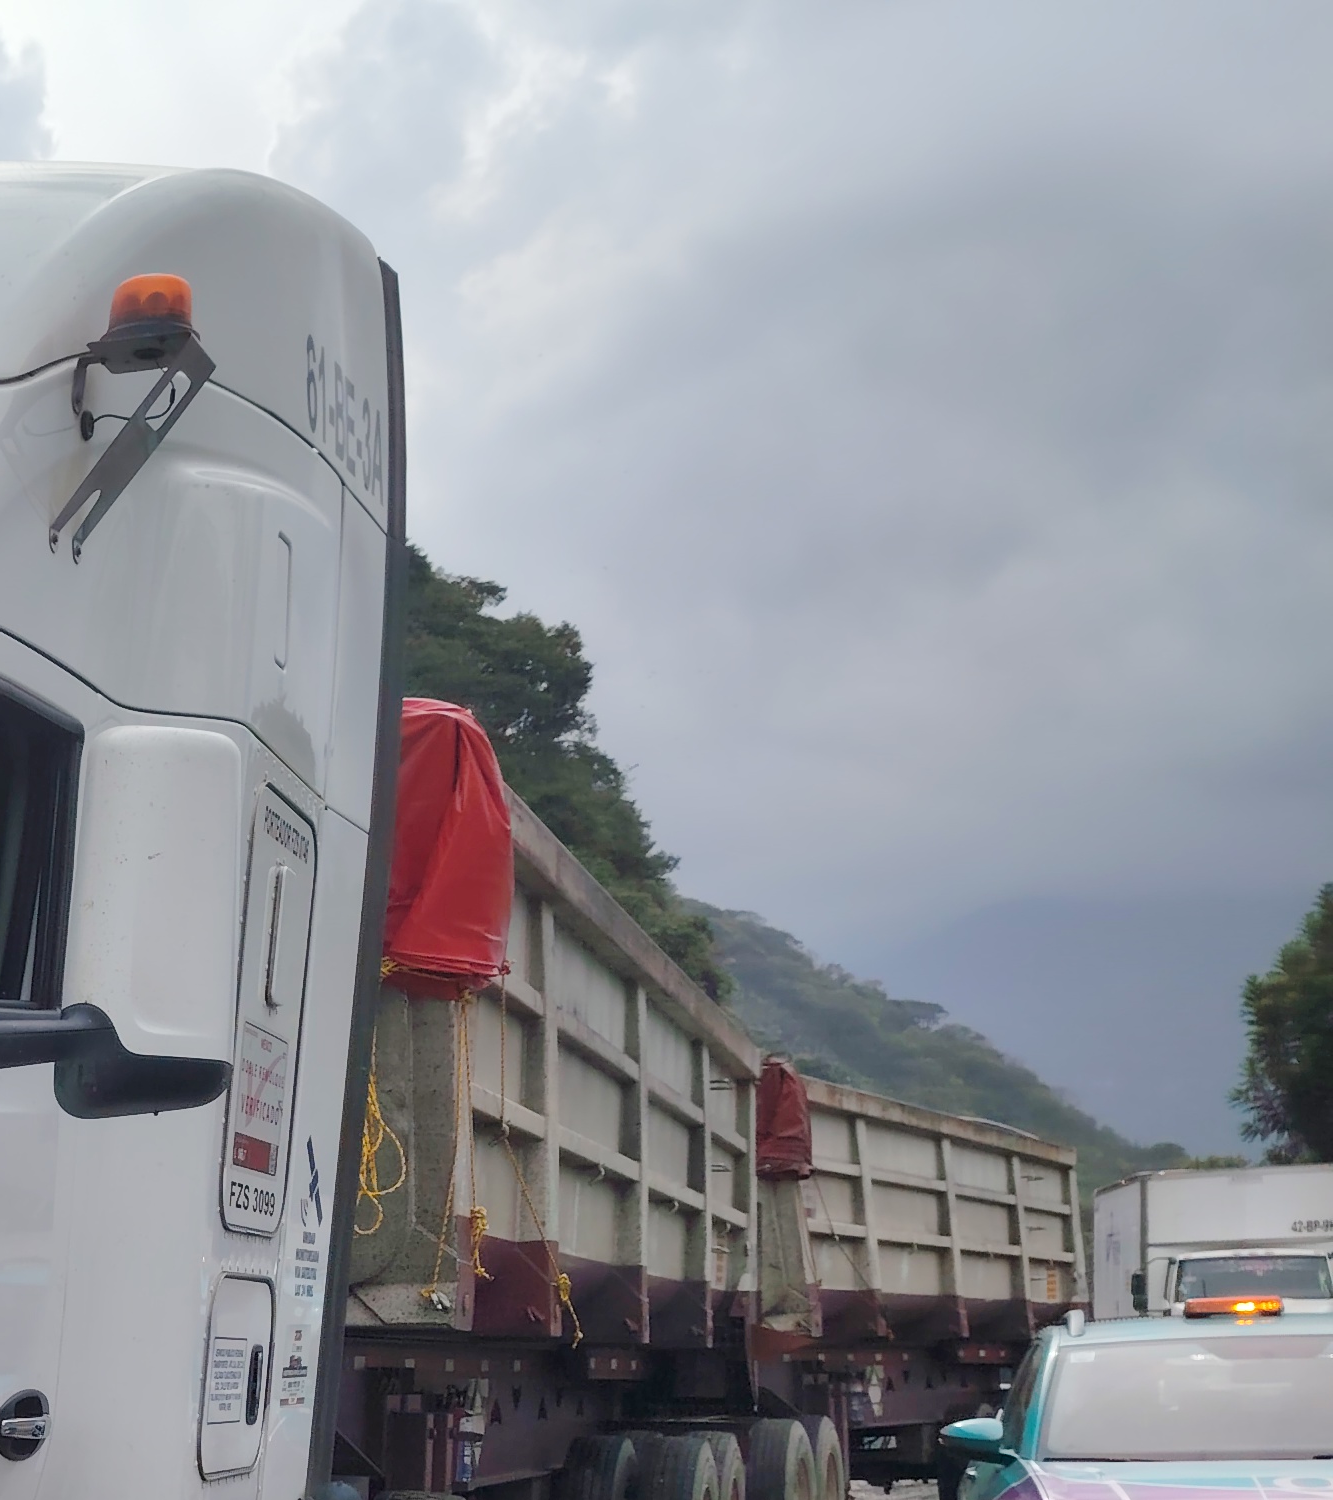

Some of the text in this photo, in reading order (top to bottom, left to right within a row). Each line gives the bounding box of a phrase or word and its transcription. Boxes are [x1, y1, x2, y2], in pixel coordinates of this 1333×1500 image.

[306, 334, 384, 507] 61-BE-3A
[241, 1093, 280, 1125] VERIFICADO
[229, 1180, 276, 1216] FZS 3099
